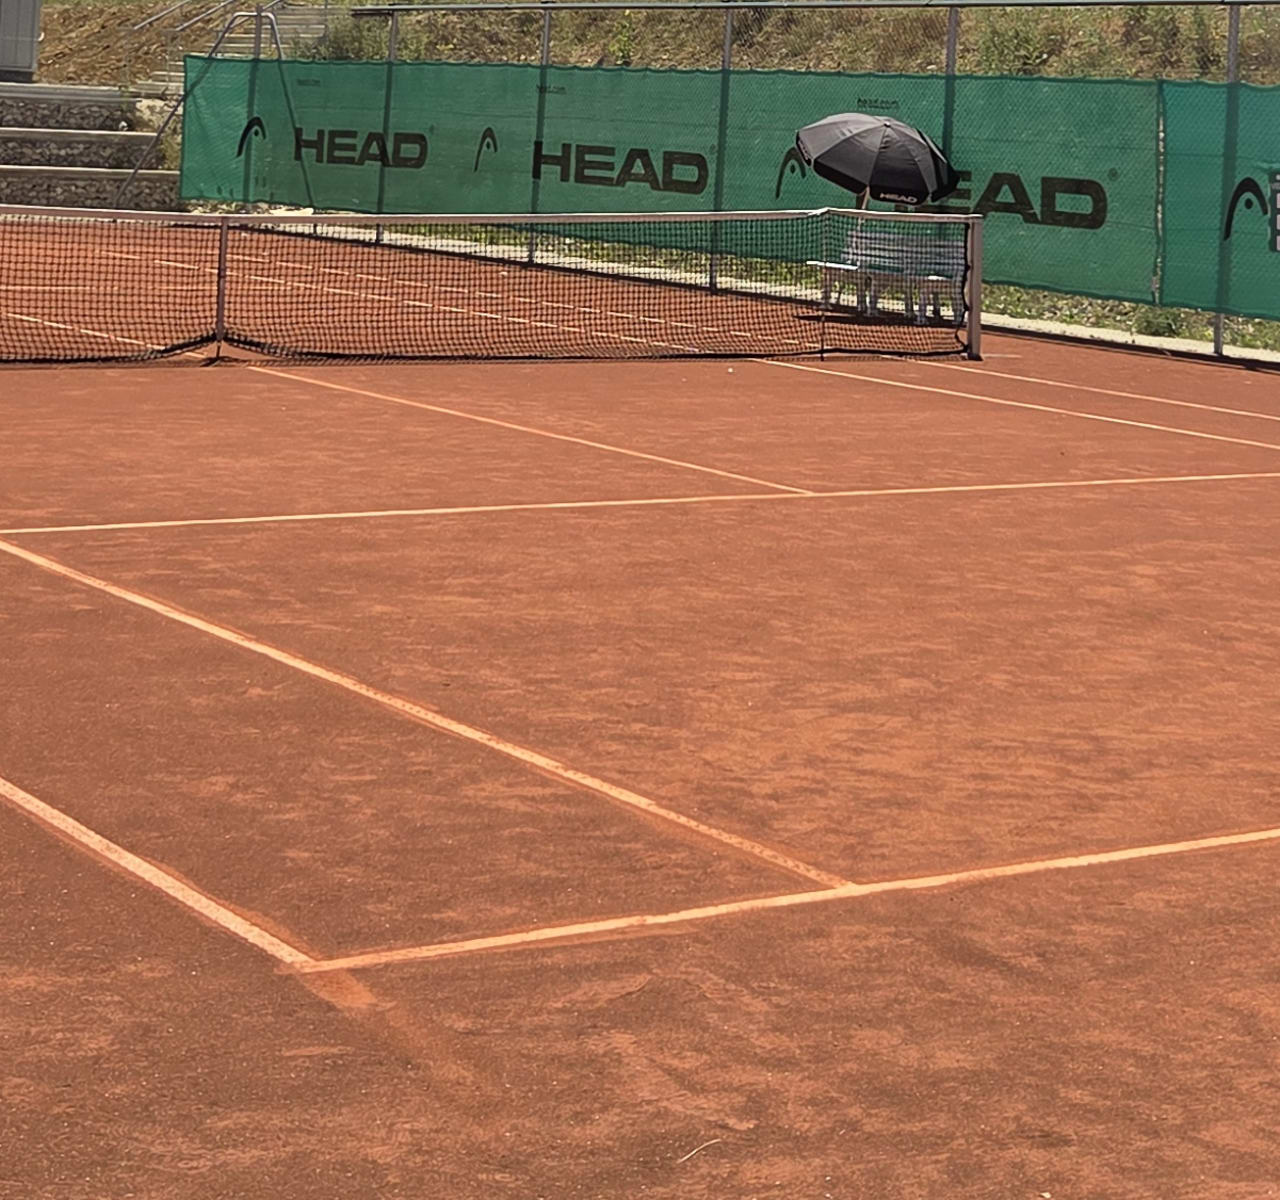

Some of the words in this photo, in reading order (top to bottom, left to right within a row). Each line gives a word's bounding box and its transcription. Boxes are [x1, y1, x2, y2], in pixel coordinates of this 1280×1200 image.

[294, 127, 429, 169] HEAD
[532, 140, 709, 195] HEAD
[878, 192, 919, 204] HEAD
